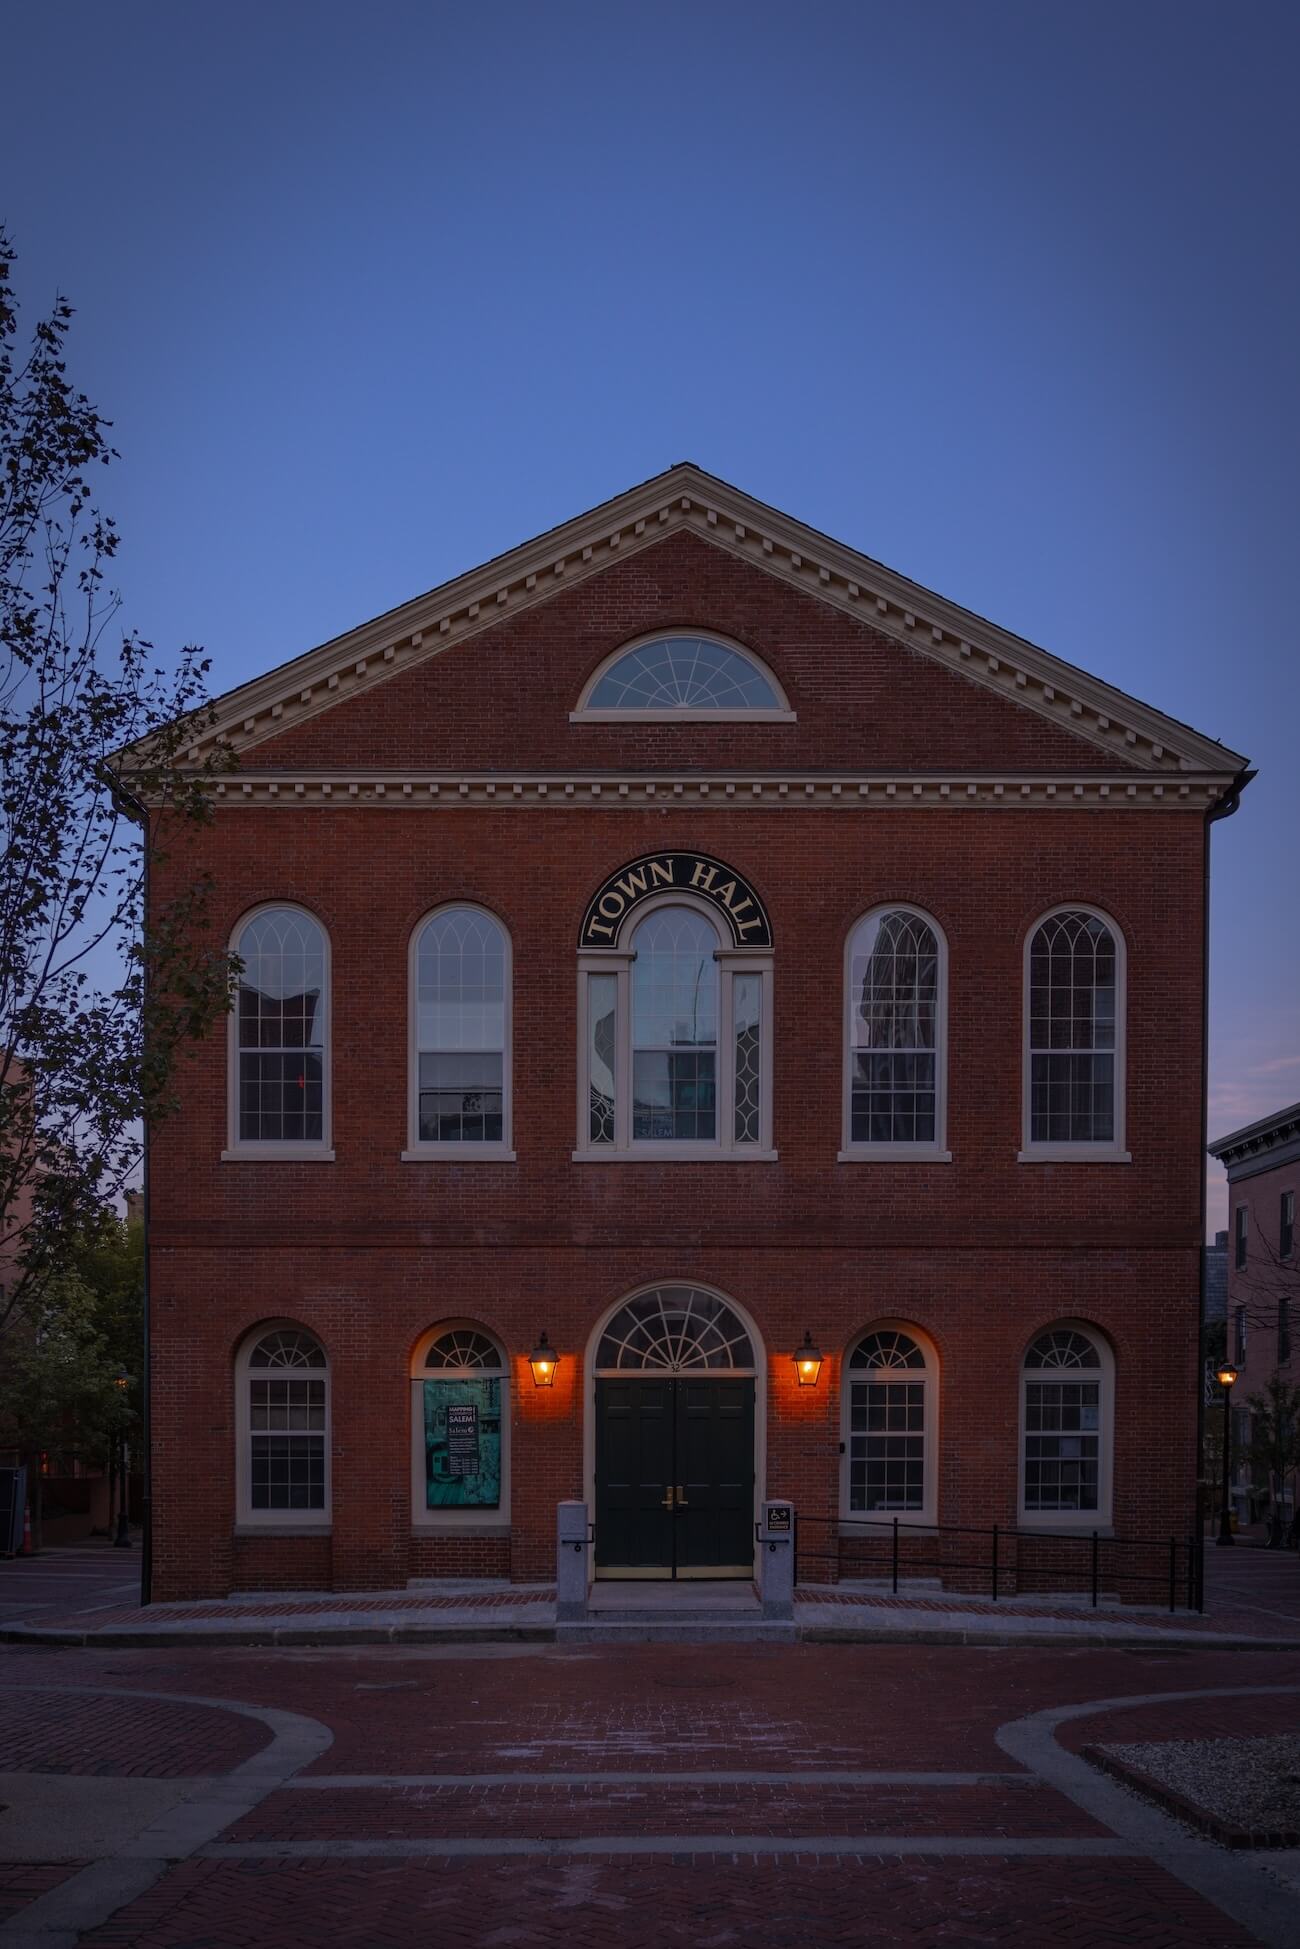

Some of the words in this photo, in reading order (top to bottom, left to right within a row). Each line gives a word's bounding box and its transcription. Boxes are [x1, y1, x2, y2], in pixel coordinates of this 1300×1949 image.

[587, 859, 674, 939] TOWN
[689, 861, 762, 941] HALL
[671, 1363, 681, 1373] 32
